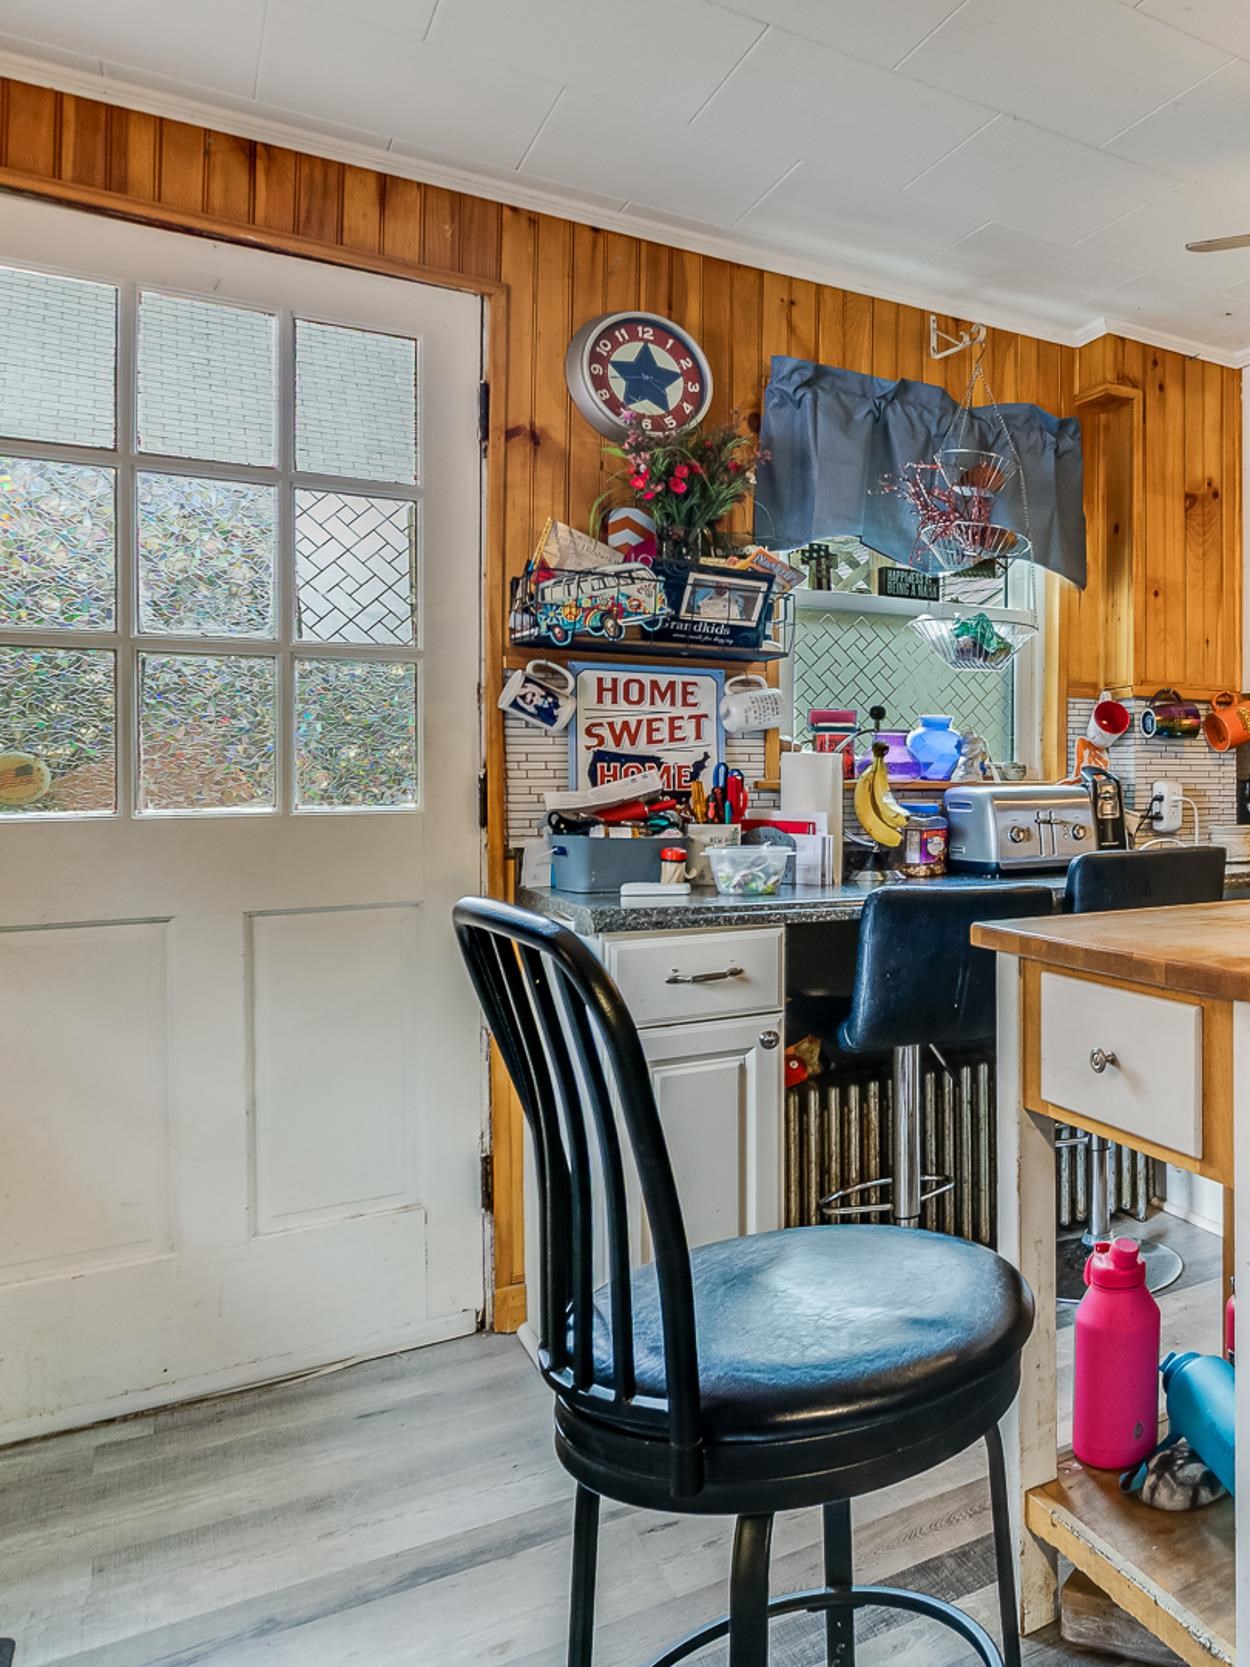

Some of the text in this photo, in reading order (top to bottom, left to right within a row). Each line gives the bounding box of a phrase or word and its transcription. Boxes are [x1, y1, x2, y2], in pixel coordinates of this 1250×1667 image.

[615, 328, 629, 342] 11
[637, 326, 654, 340] 12
[596, 339, 612, 356] 10
[664, 339, 674, 349] 1
[590, 363, 603, 376] 9
[680, 358, 692, 370] 2
[688, 381, 700, 393] 3
[597, 388, 610, 401] 8
[682, 401, 694, 414] 4
[641, 419, 652, 430] 6
[664, 416, 677, 428] 5
[596, 676, 699, 708] HOME
[584, 713, 710, 751] SWEET
